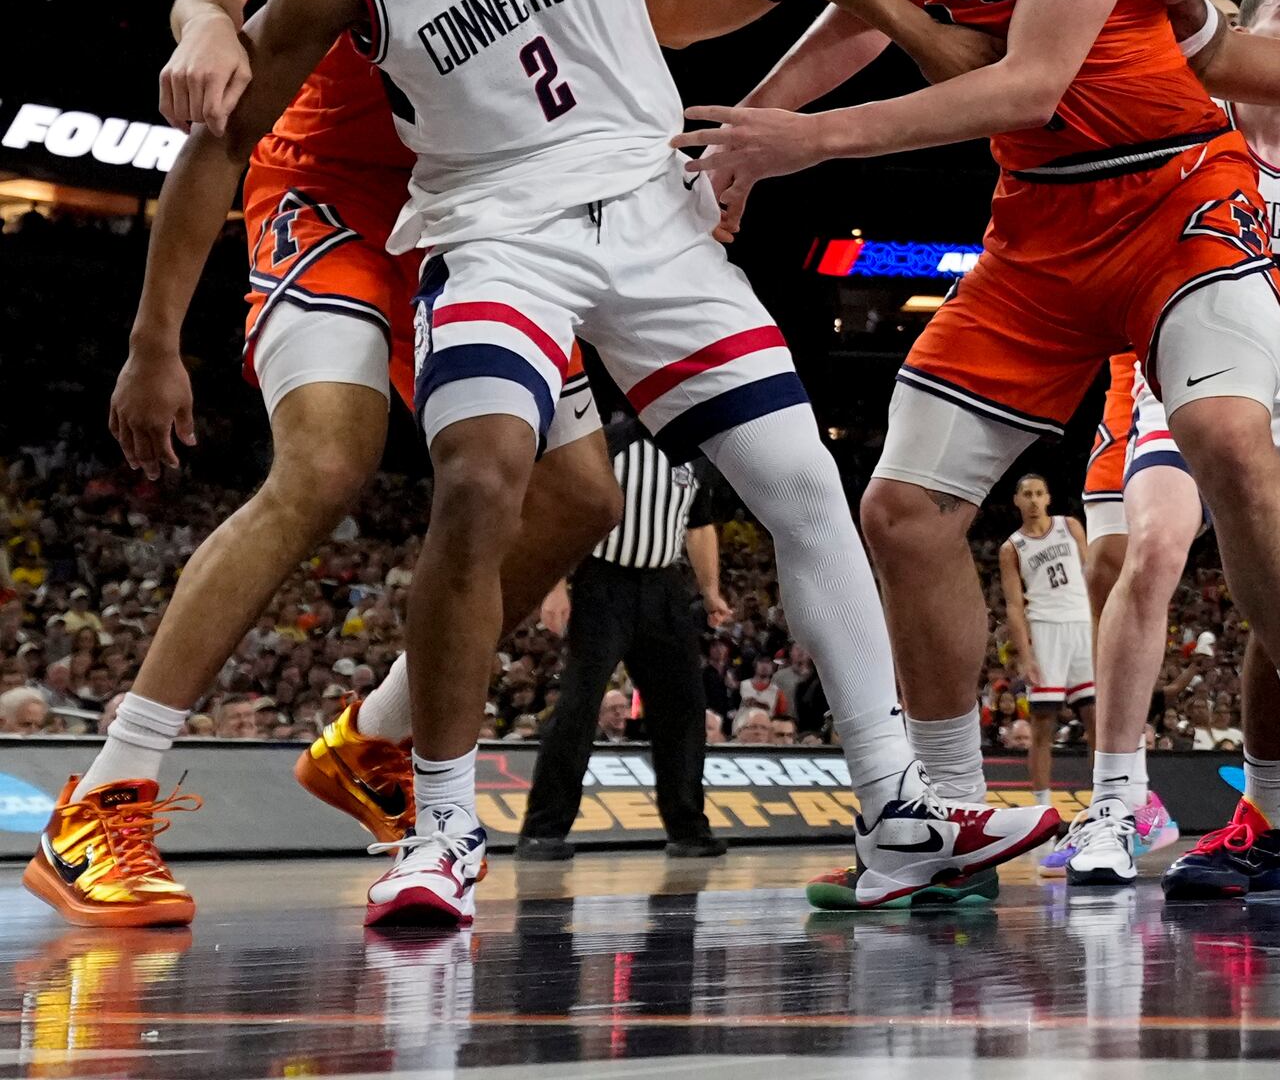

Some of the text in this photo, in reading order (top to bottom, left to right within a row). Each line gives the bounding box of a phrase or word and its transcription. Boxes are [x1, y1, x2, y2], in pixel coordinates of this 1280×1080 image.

[519, 35, 577, 122] 2
[2, 103, 188, 172] FOUR
[1047, 562, 1068, 588] 23
